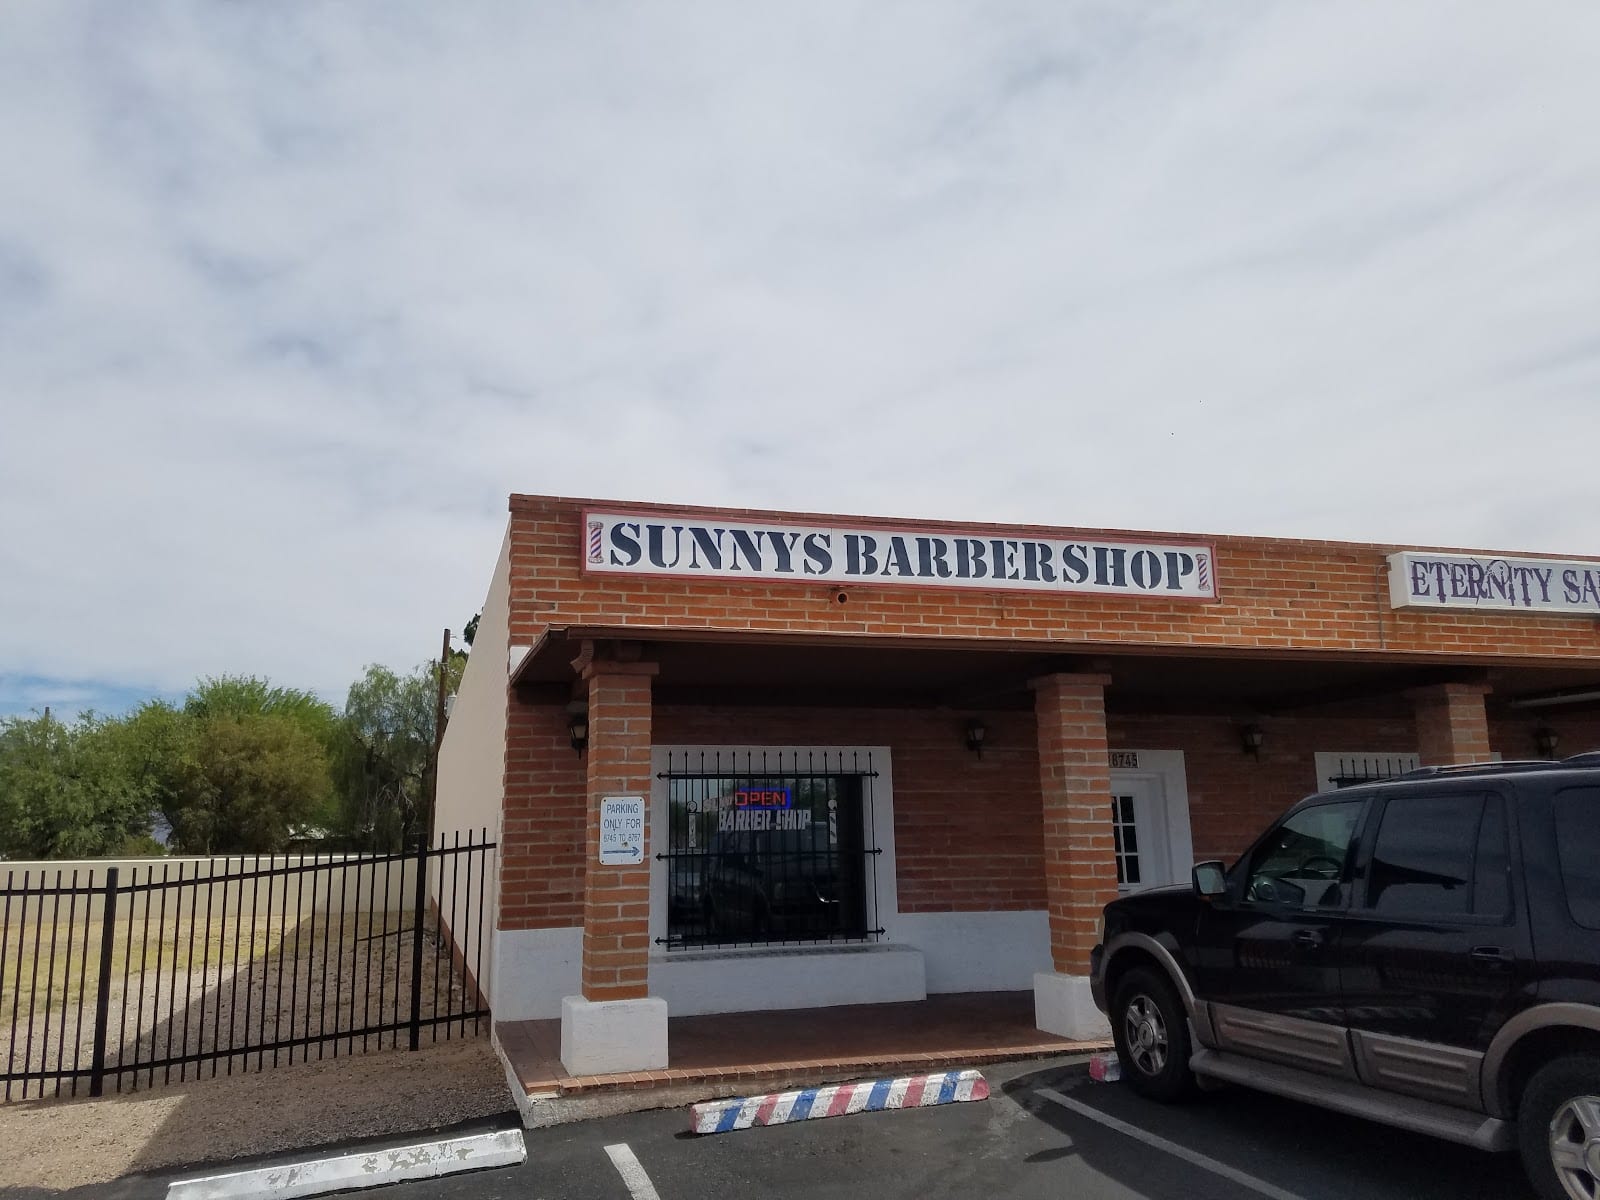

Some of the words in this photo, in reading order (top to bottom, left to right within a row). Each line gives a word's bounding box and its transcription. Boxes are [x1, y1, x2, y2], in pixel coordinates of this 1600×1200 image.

[610, 523, 832, 575] SUNNYS
[1562, 569, 1600, 608] SA
[735, 792, 786, 806] OPEN
[607, 804, 639, 814] PARKING
[604, 819, 622, 829] ONLY
[626, 819, 640, 829] FOR
[719, 810, 772, 831] BARBER
[775, 810, 812, 830] SHOP
[619, 834, 626, 842] TO
